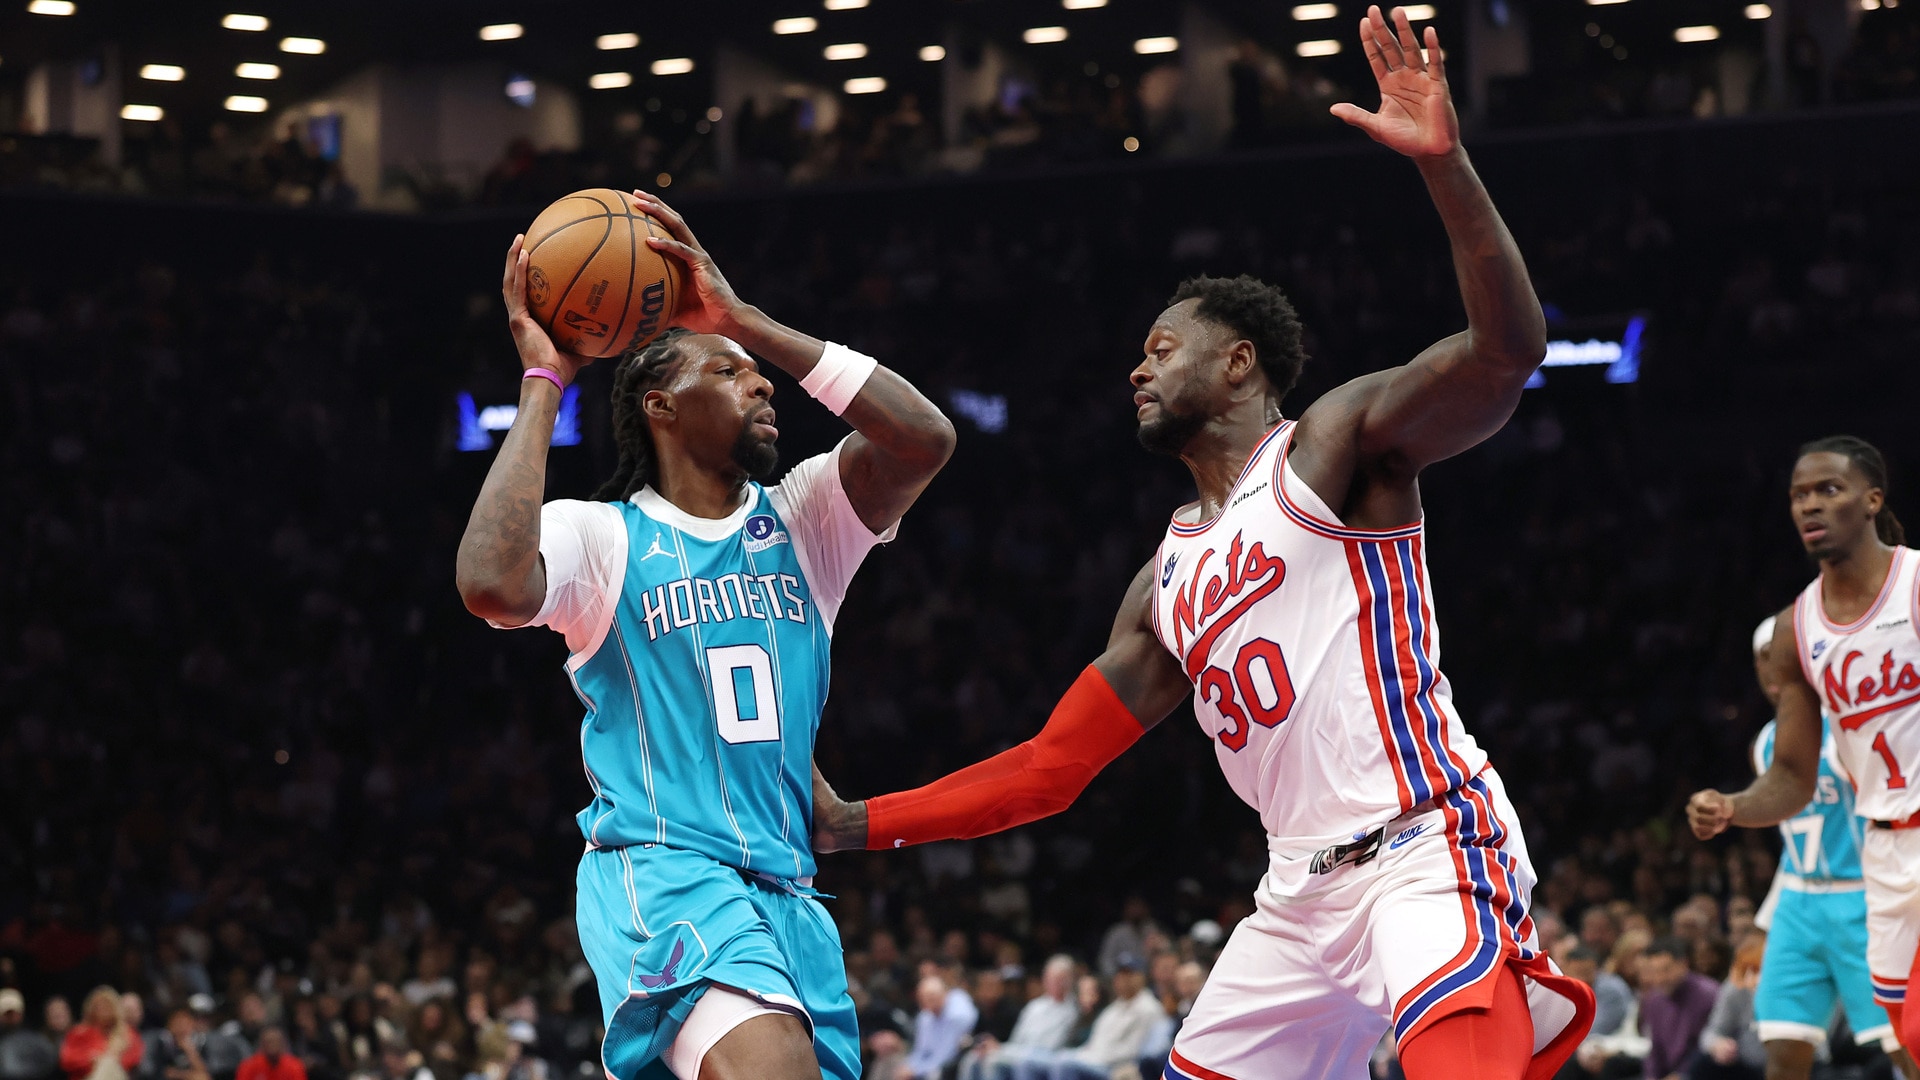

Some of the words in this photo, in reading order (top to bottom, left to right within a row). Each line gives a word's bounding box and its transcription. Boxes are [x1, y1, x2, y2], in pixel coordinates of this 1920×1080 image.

[1231, 482, 1268, 509] Alibaba
[641, 572, 807, 642] HORNETS
[1173, 528, 1286, 664] Nets
[705, 643, 781, 745] 0
[1201, 637, 1297, 753] 30
[1824, 649, 1920, 714] Nets
[1872, 731, 1907, 789] 1
[1396, 823, 1425, 842] NIKE
